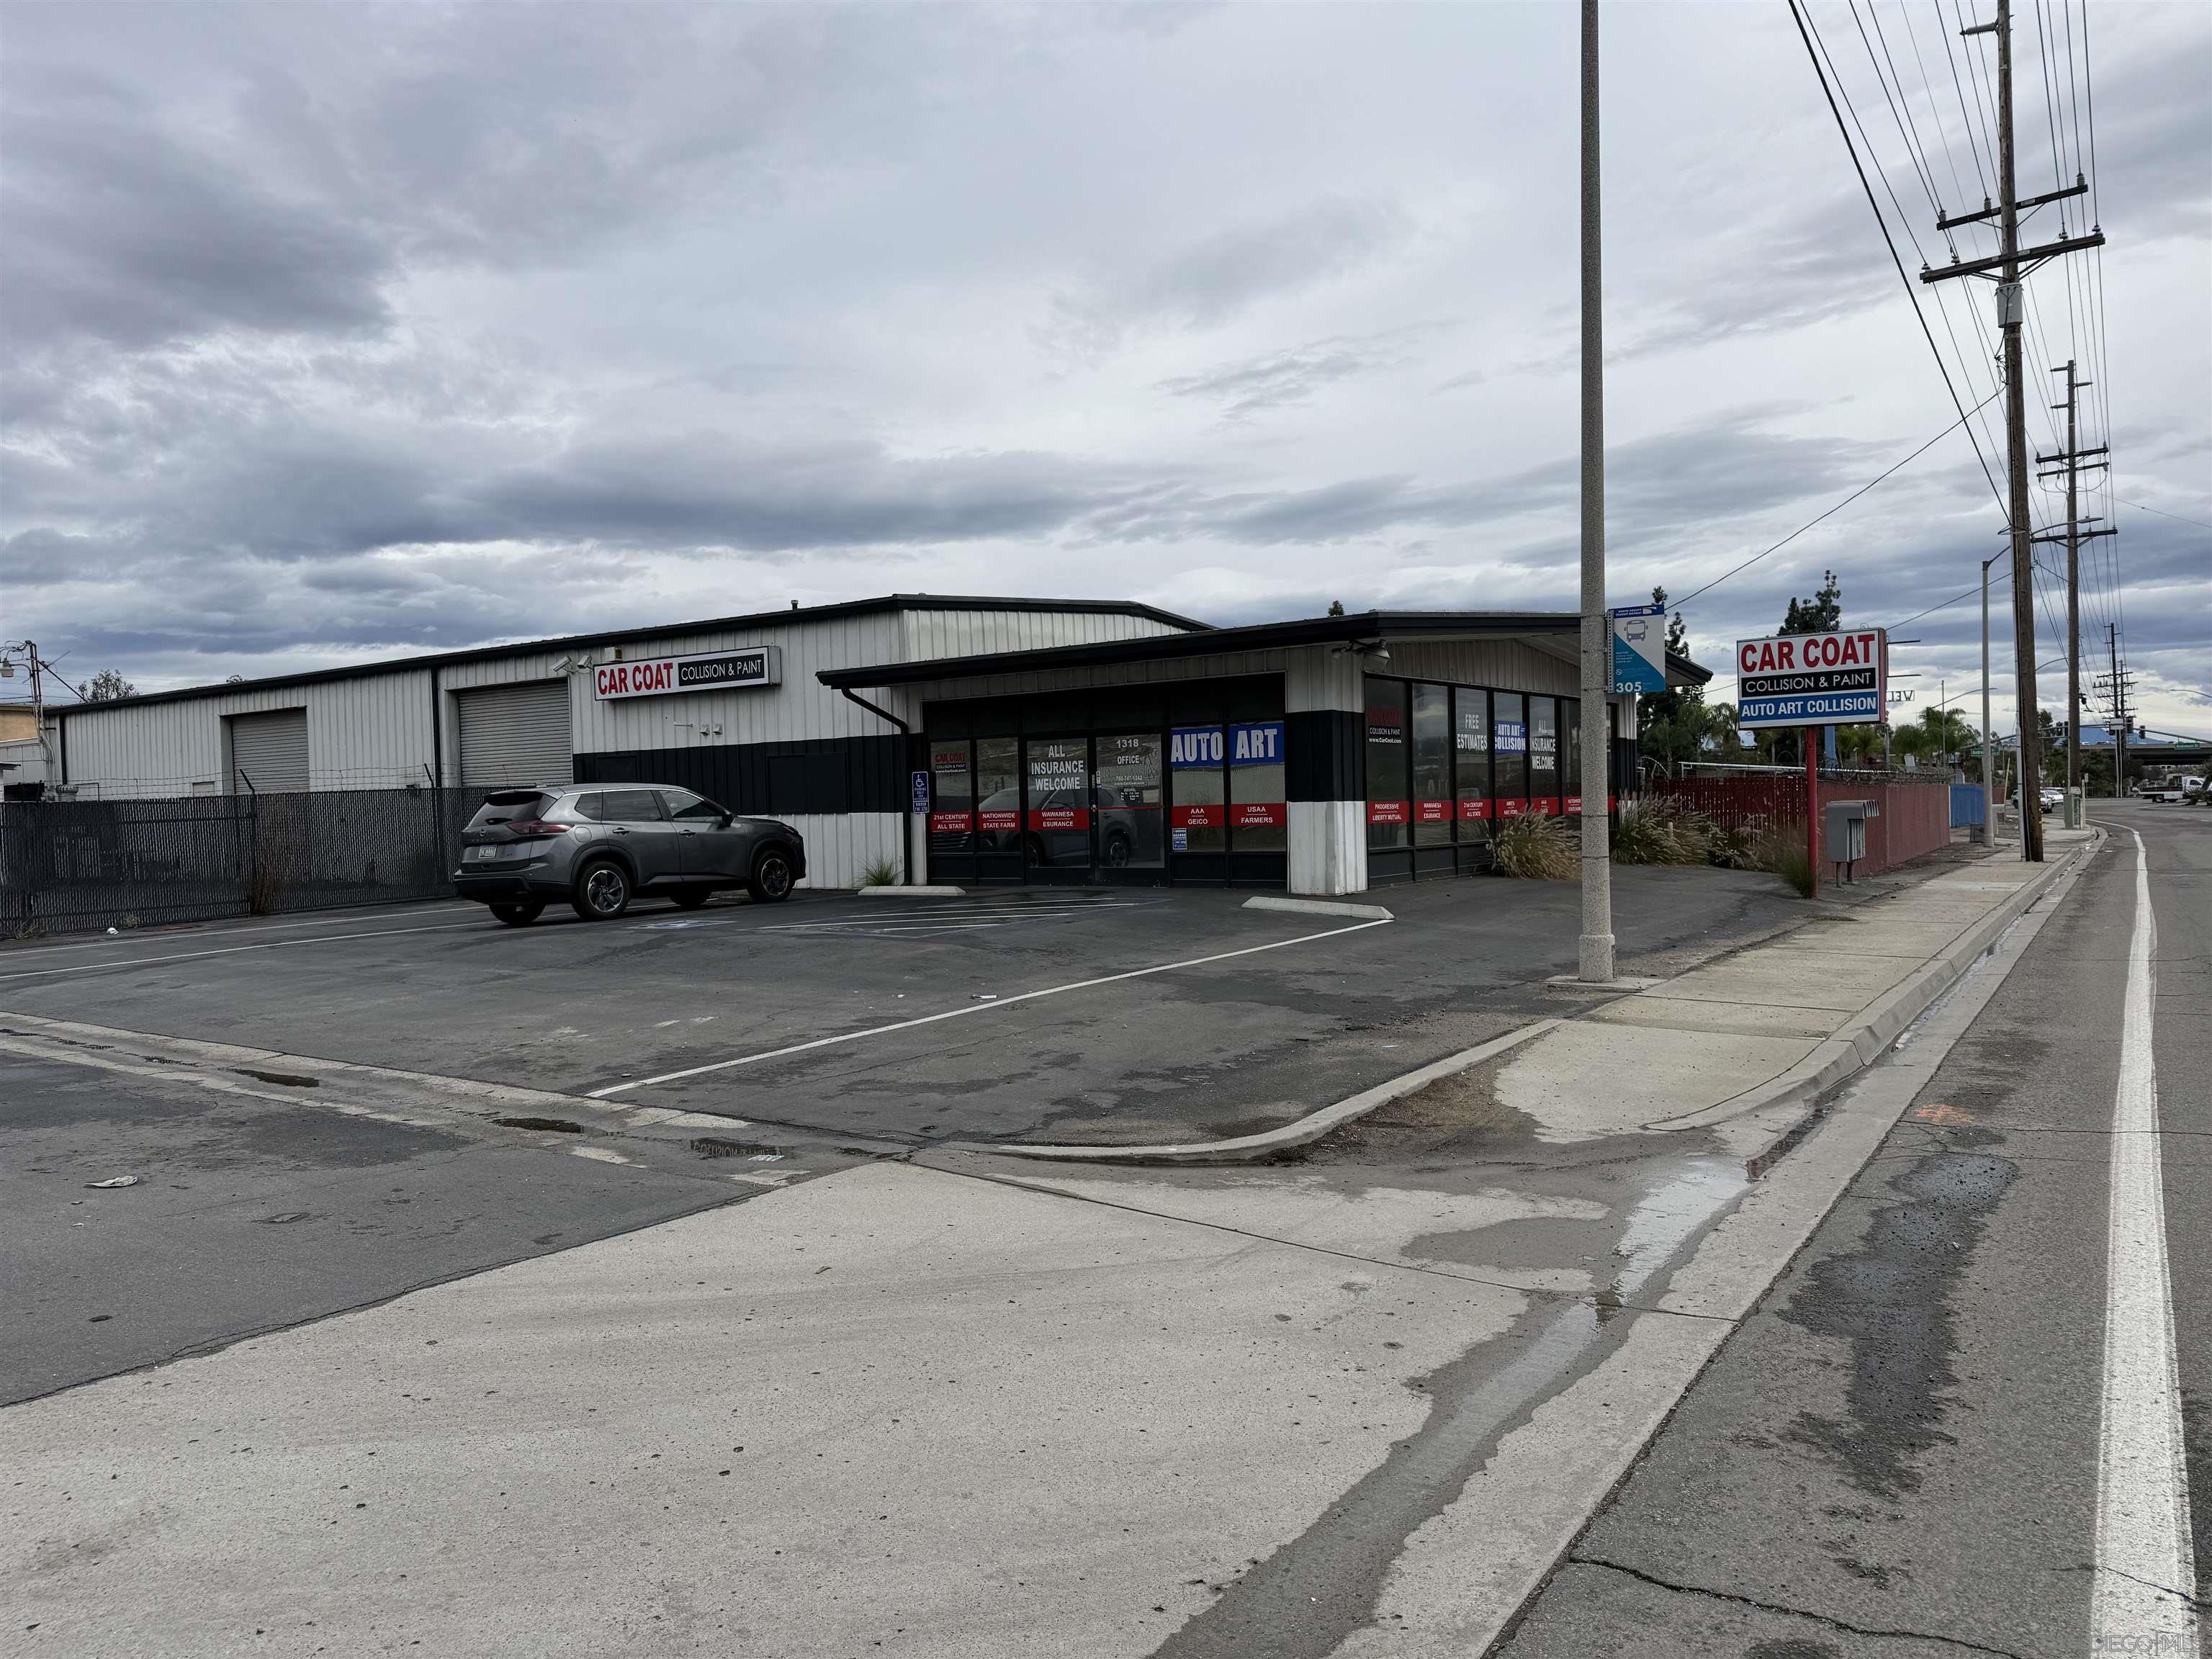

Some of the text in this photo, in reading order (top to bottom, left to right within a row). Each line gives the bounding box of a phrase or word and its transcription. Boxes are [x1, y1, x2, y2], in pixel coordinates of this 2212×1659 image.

[1740, 634, 1875, 673] CAR COAT
[598, 660, 762, 695] CAR COAT COLLISION & PAINT
[1745, 673, 1871, 693] COLLISION & PAINT
[1616, 682, 1642, 692] 305
[1742, 697, 1876, 717] AUTO ART COLLISION
[1465, 714, 1479, 729] FREE
[1498, 724, 1520, 736] AUTO ART
[1116, 739, 1139, 748] 1318
[1171, 729, 1277, 762] AUTO ART
[1457, 733, 1488, 750] ESTIMATES
[1529, 737, 1555, 752] INSURANCE
[1048, 745, 1065, 757] ALL
[1118, 755, 1139, 764] OFFICE
[1532, 756, 1555, 770] WELCOME
[1031, 760, 1084, 775] INSURANCE
[1035, 776, 1080, 791] WELCOME
